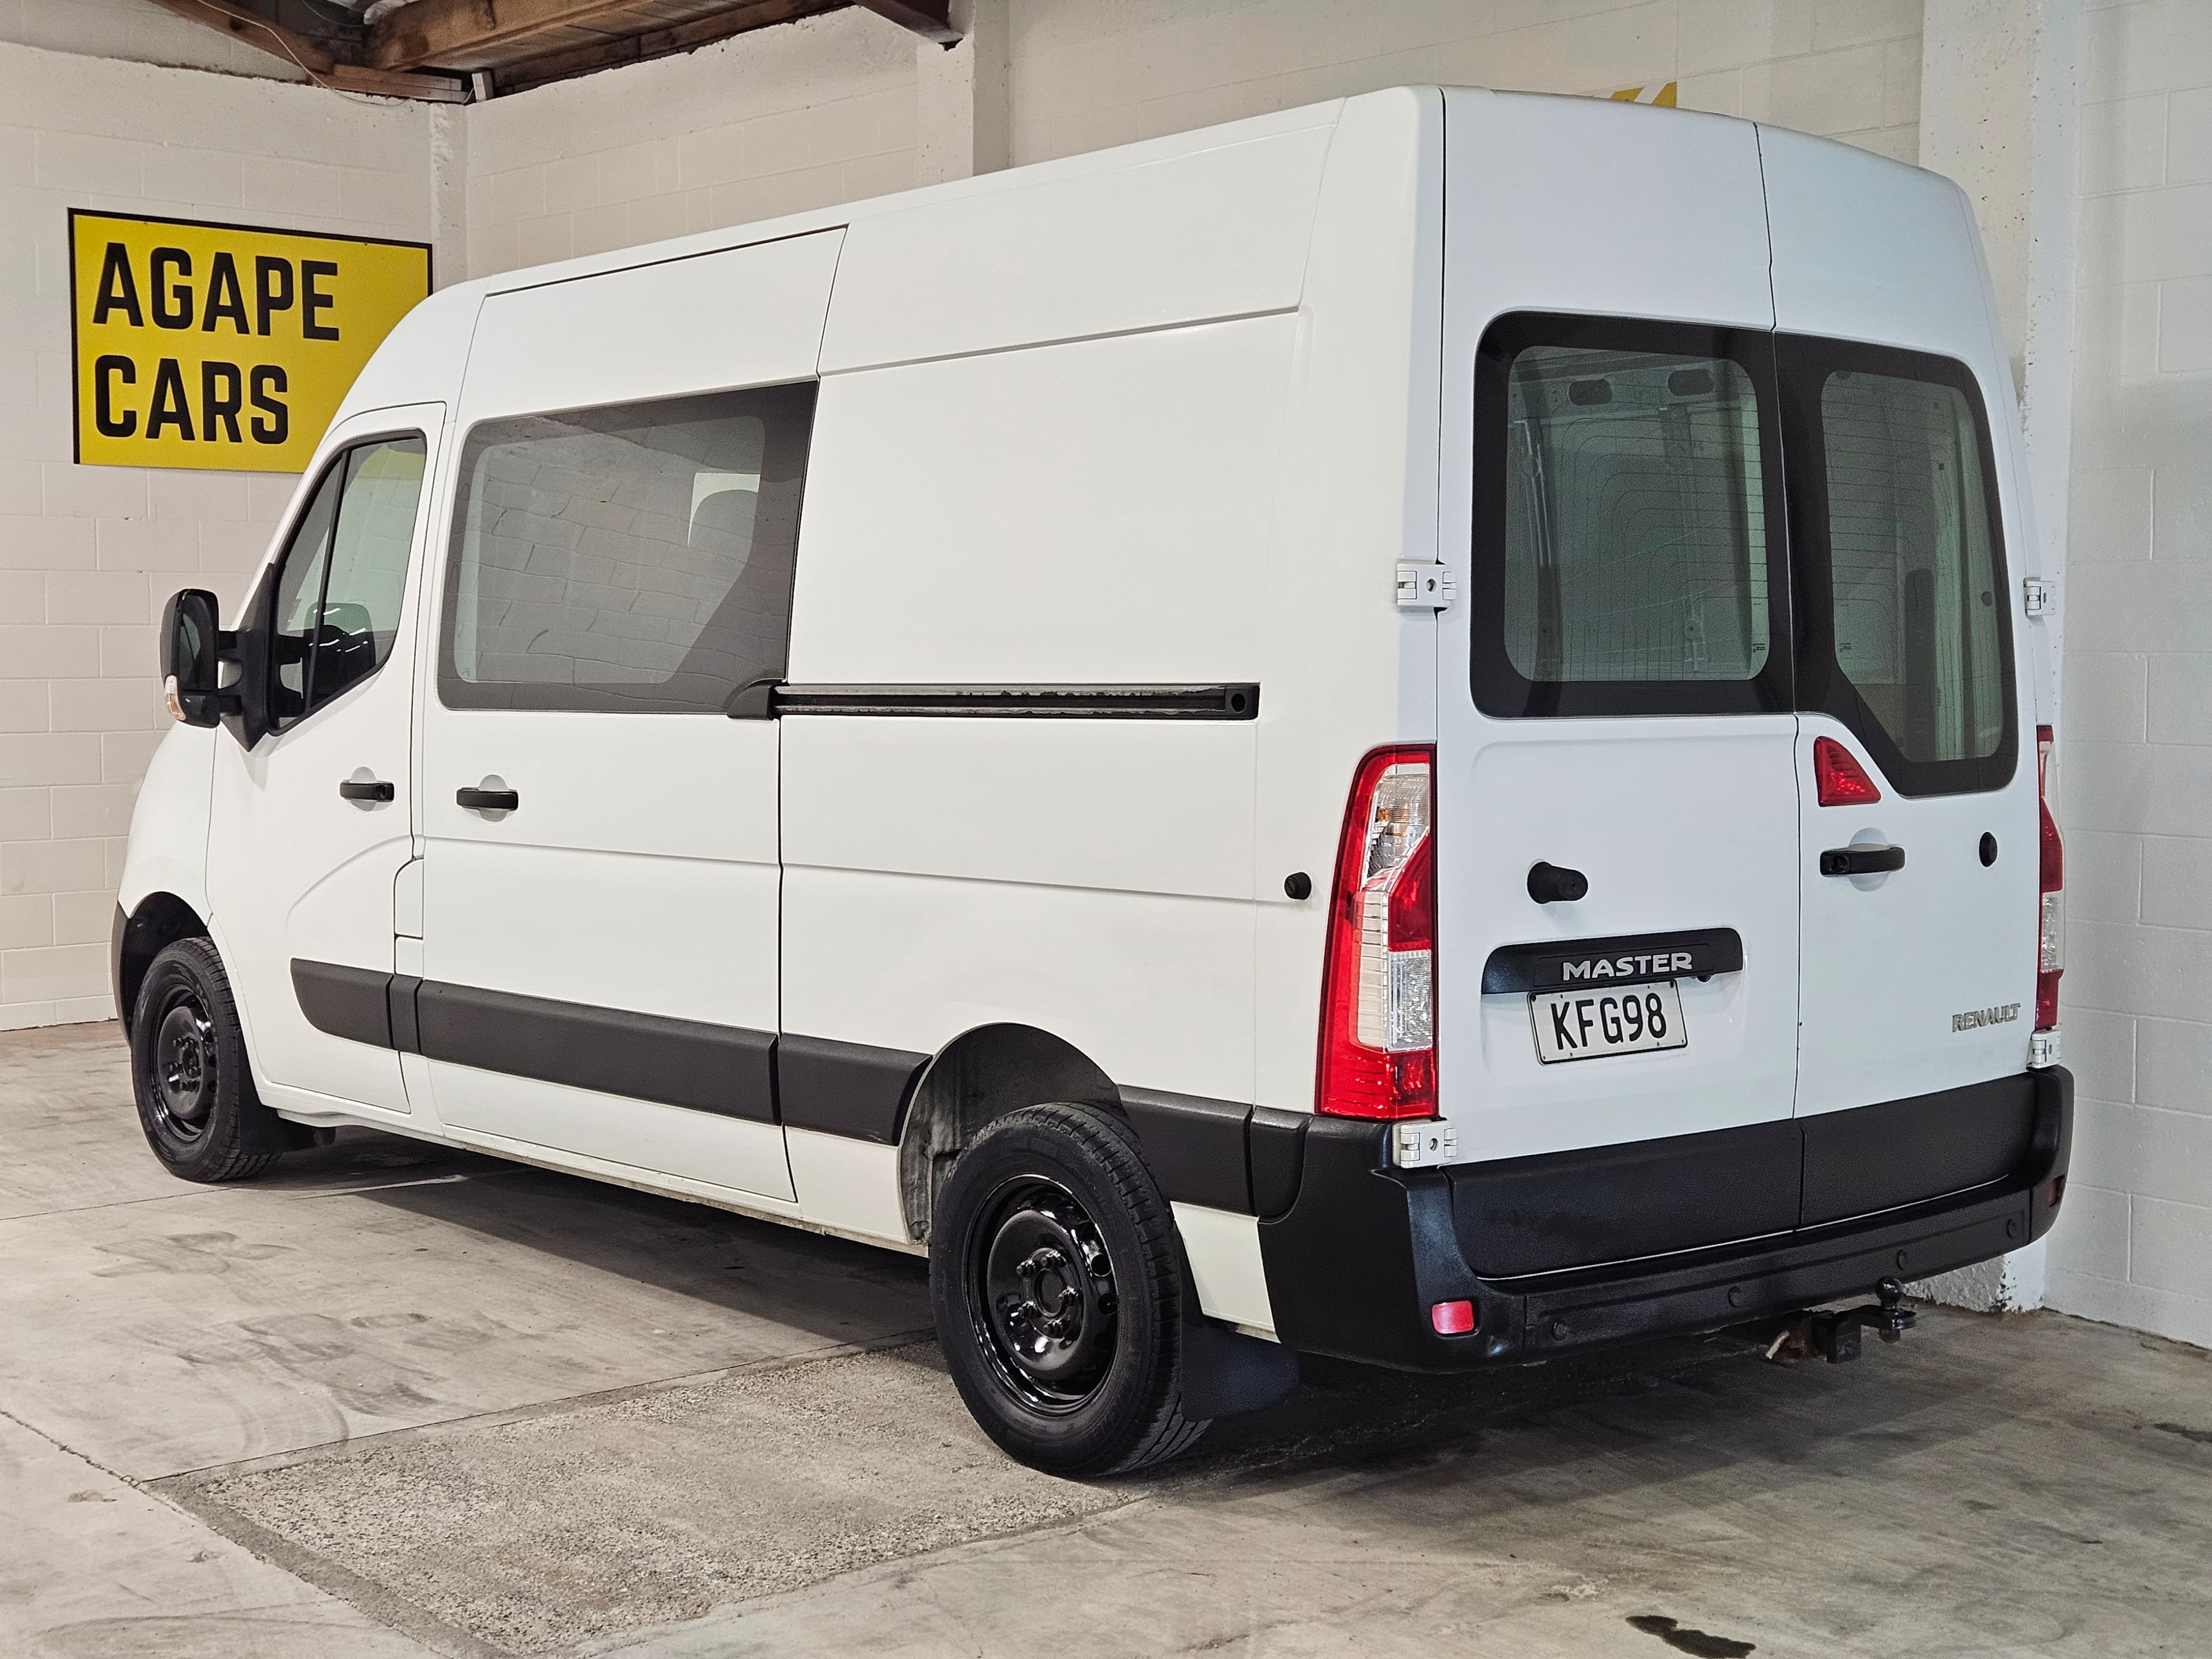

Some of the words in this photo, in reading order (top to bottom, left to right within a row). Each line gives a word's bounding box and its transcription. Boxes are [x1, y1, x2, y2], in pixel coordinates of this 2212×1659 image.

[93, 242, 339, 341] AGAPE
[94, 354, 289, 444] CARS
[1563, 952, 1692, 981] MASTER
[1550, 993, 1666, 1050] KFG98
[1952, 1003, 2021, 1032] RENAULT
